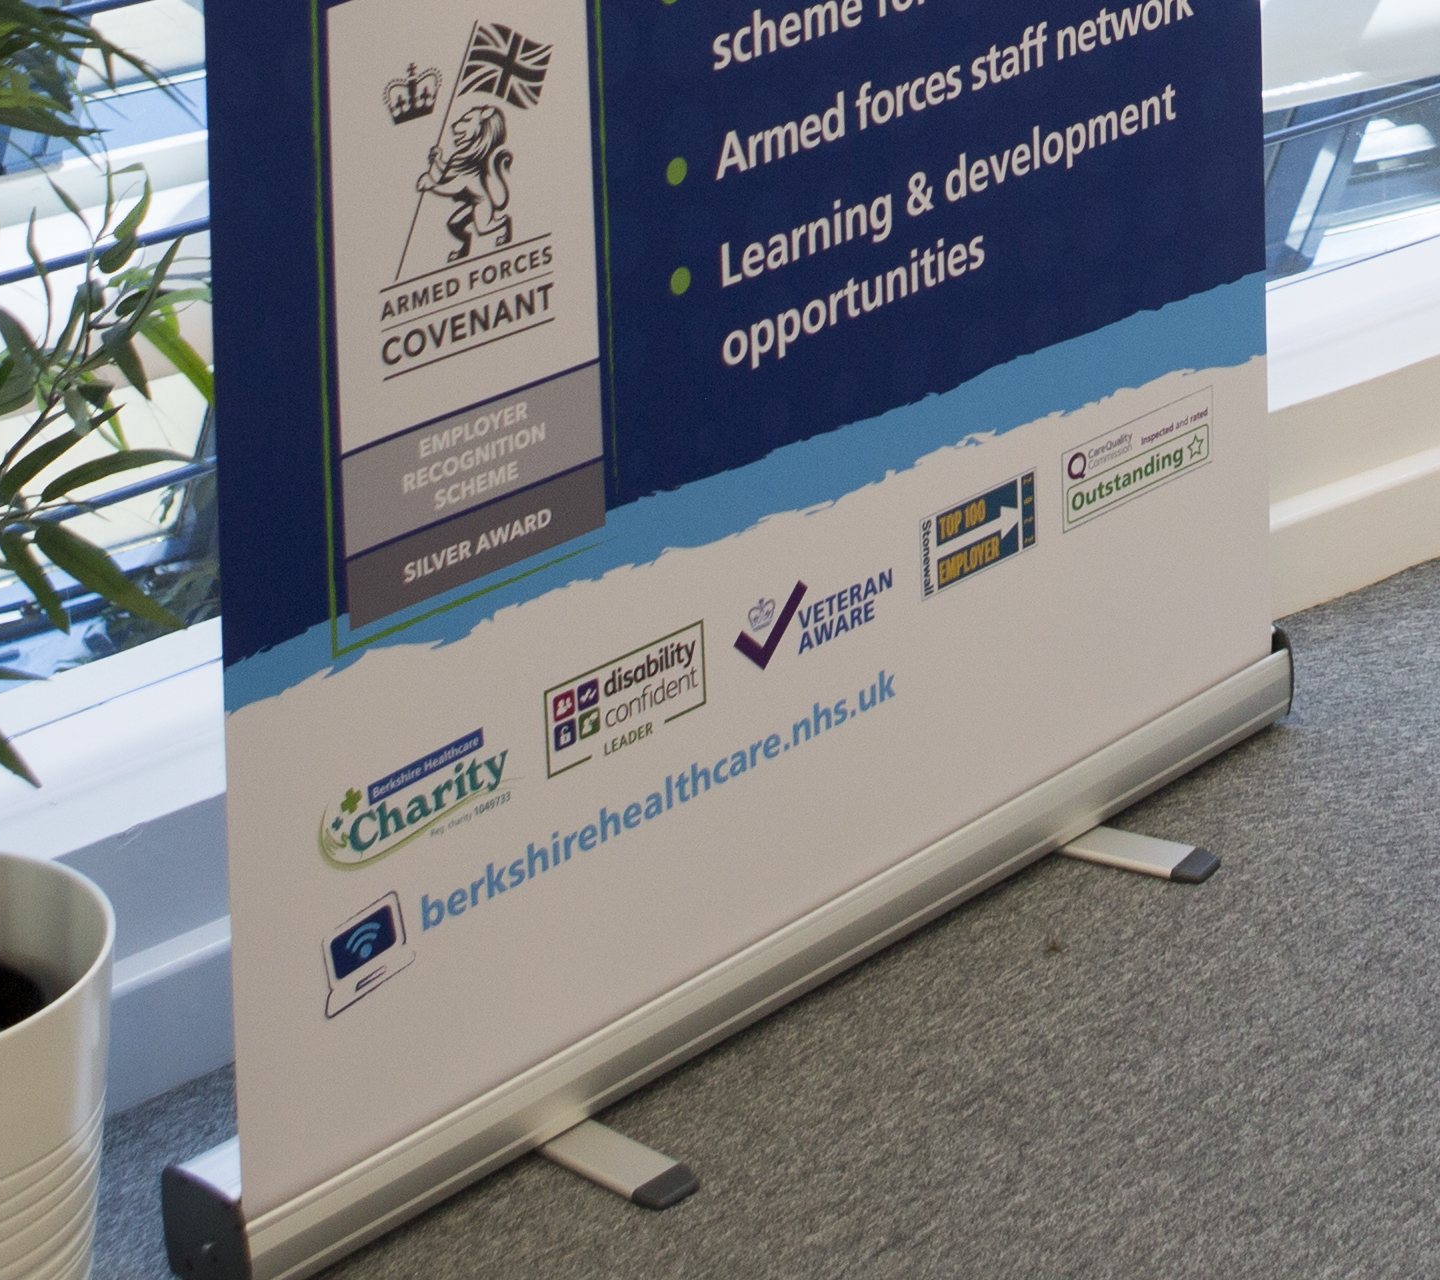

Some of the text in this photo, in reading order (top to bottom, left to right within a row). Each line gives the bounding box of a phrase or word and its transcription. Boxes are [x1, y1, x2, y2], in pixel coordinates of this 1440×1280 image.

[715, 91, 846, 180] Armed
[856, 64, 962, 131] forces
[971, 22, 1048, 91] staff
[720, 84, 1176, 289] Learning & development
[380, 245, 553, 322] ARMED FORCES
[721, 234, 985, 370] opportunities
[381, 282, 554, 366] COVENANT
[401, 421, 546, 494] RECOGNITION
[417, 401, 528, 459] EMPLOYER
[1088, 444, 1133, 470] Commission
[1140, 406, 1208, 446] Inspected and rated
[433, 460, 519, 510] SCHEME
[1071, 447, 1183, 511] Outstanding
[403, 508, 552, 584] SILVER AWARD
[939, 498, 986, 540] TOP 100
[922, 519, 934, 597] Stonewall
[939, 535, 1000, 585] EMPLOYER
[797, 567, 893, 630] VETERAN
[797, 599, 875, 656] AWARE
[603, 639, 696, 697] disability
[604, 666, 699, 728] confident
[372, 736, 479, 799] Berkshire Healthcare
[603, 721, 654, 757] LEADER
[349, 748, 509, 852] Charity
[420, 670, 896, 931] berkshirehealthcare.nhs.uk
[447, 812, 473, 829] charity
[474, 791, 512, 816] 1049733
